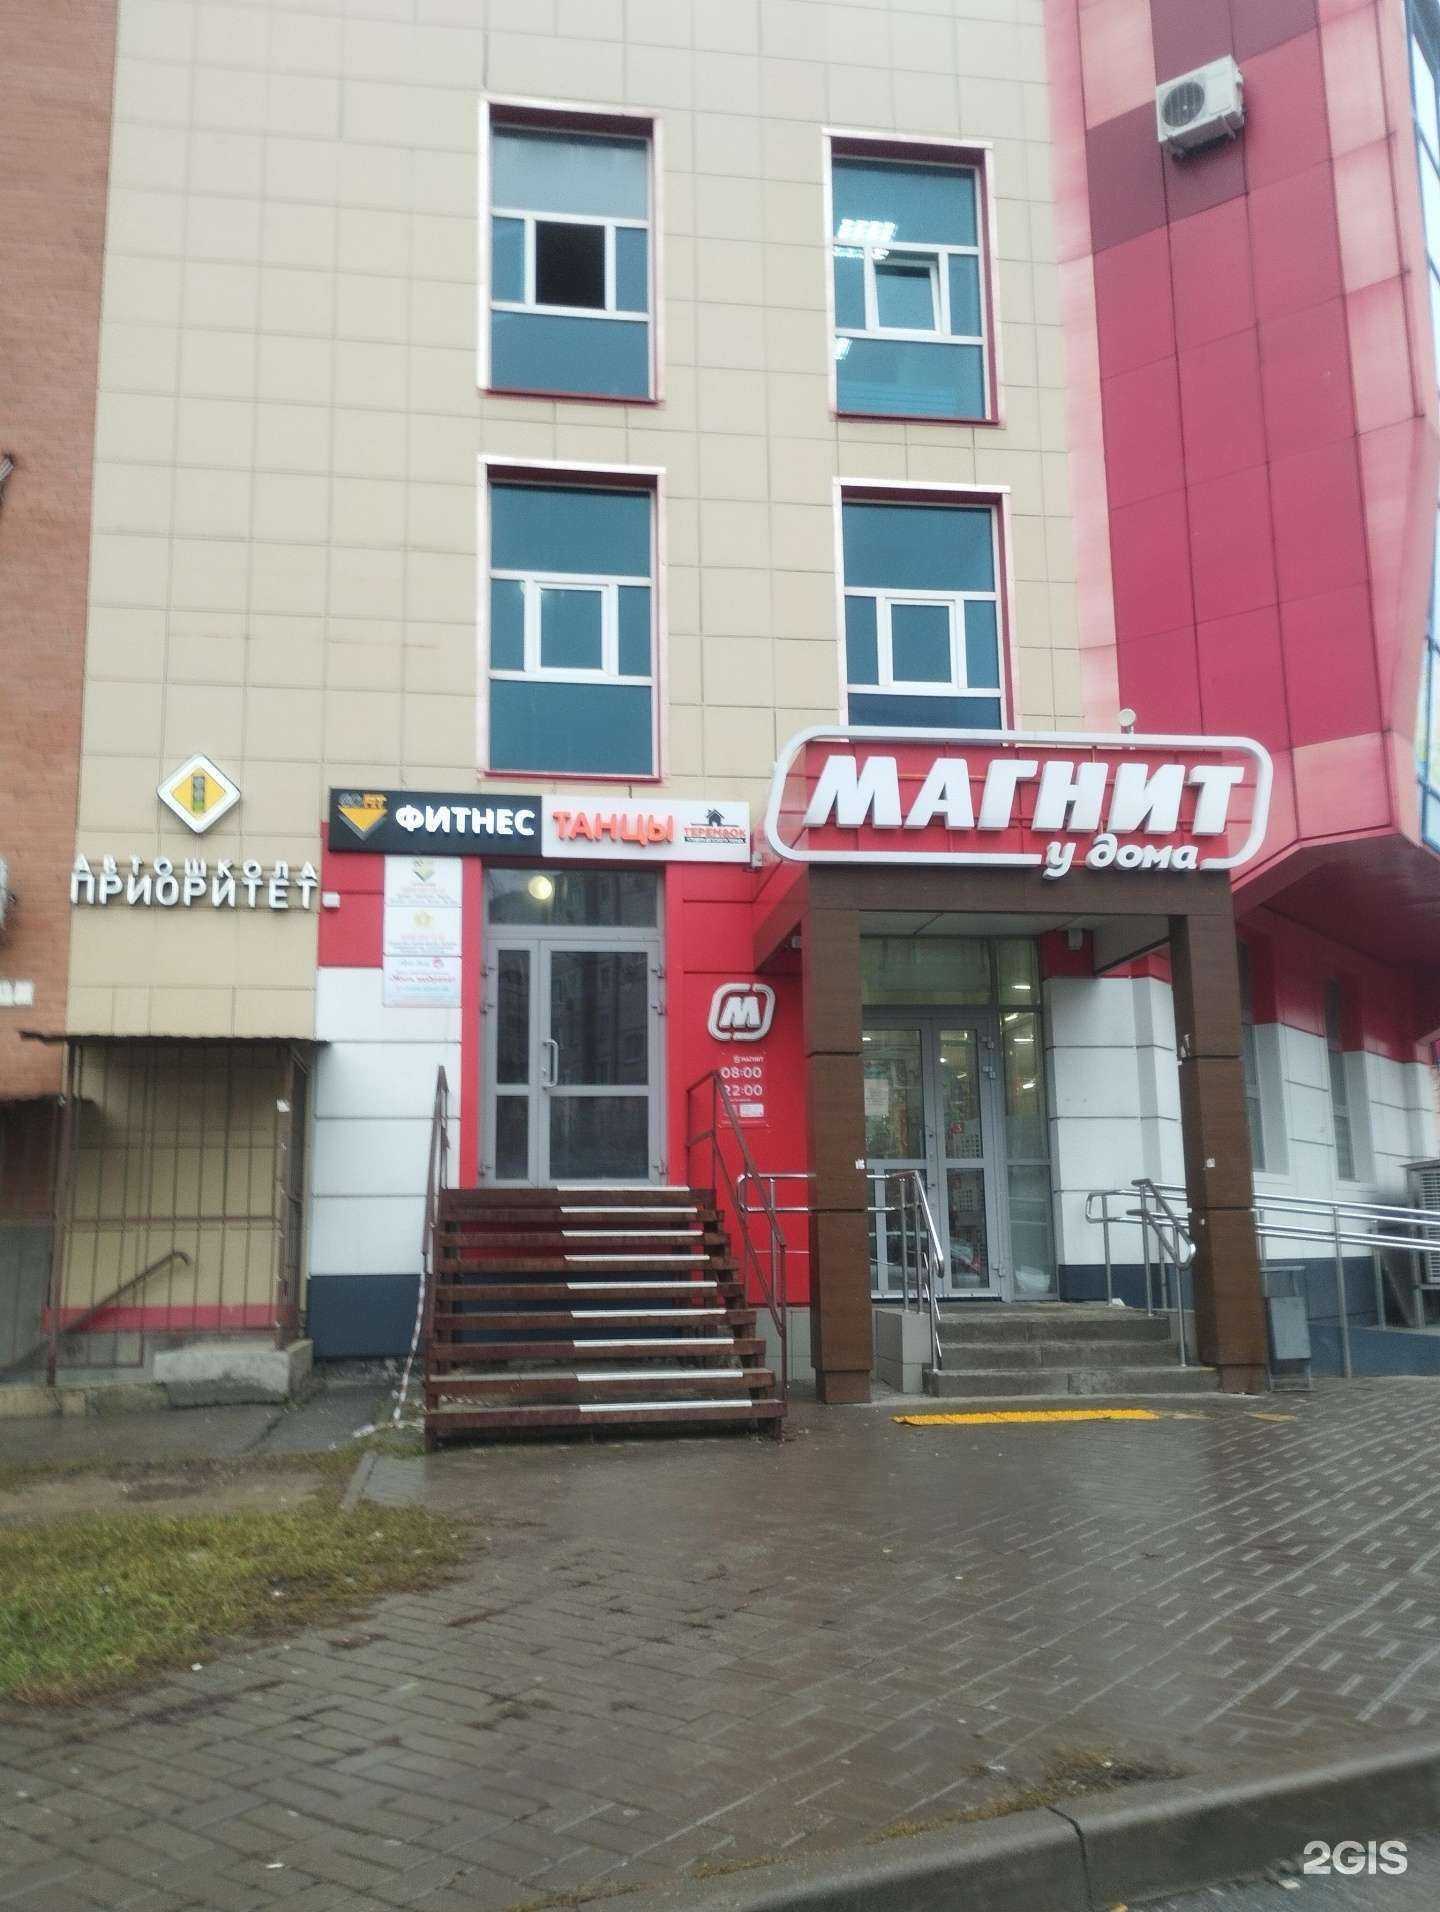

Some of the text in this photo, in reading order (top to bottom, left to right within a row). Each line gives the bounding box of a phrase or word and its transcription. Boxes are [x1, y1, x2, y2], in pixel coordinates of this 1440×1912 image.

[802, 755, 1245, 835] МАГНИТ
[395, 804, 536, 837] ФИТНЕС
[552, 811, 674, 847] ТАНЦЫ
[73, 852, 319, 880] АВТОШКОЛА
[1041, 832, 1199, 880] у дома
[69, 871, 319, 910] ПРИОРИТЕТ
[720, 1067, 762, 1079] 08:00
